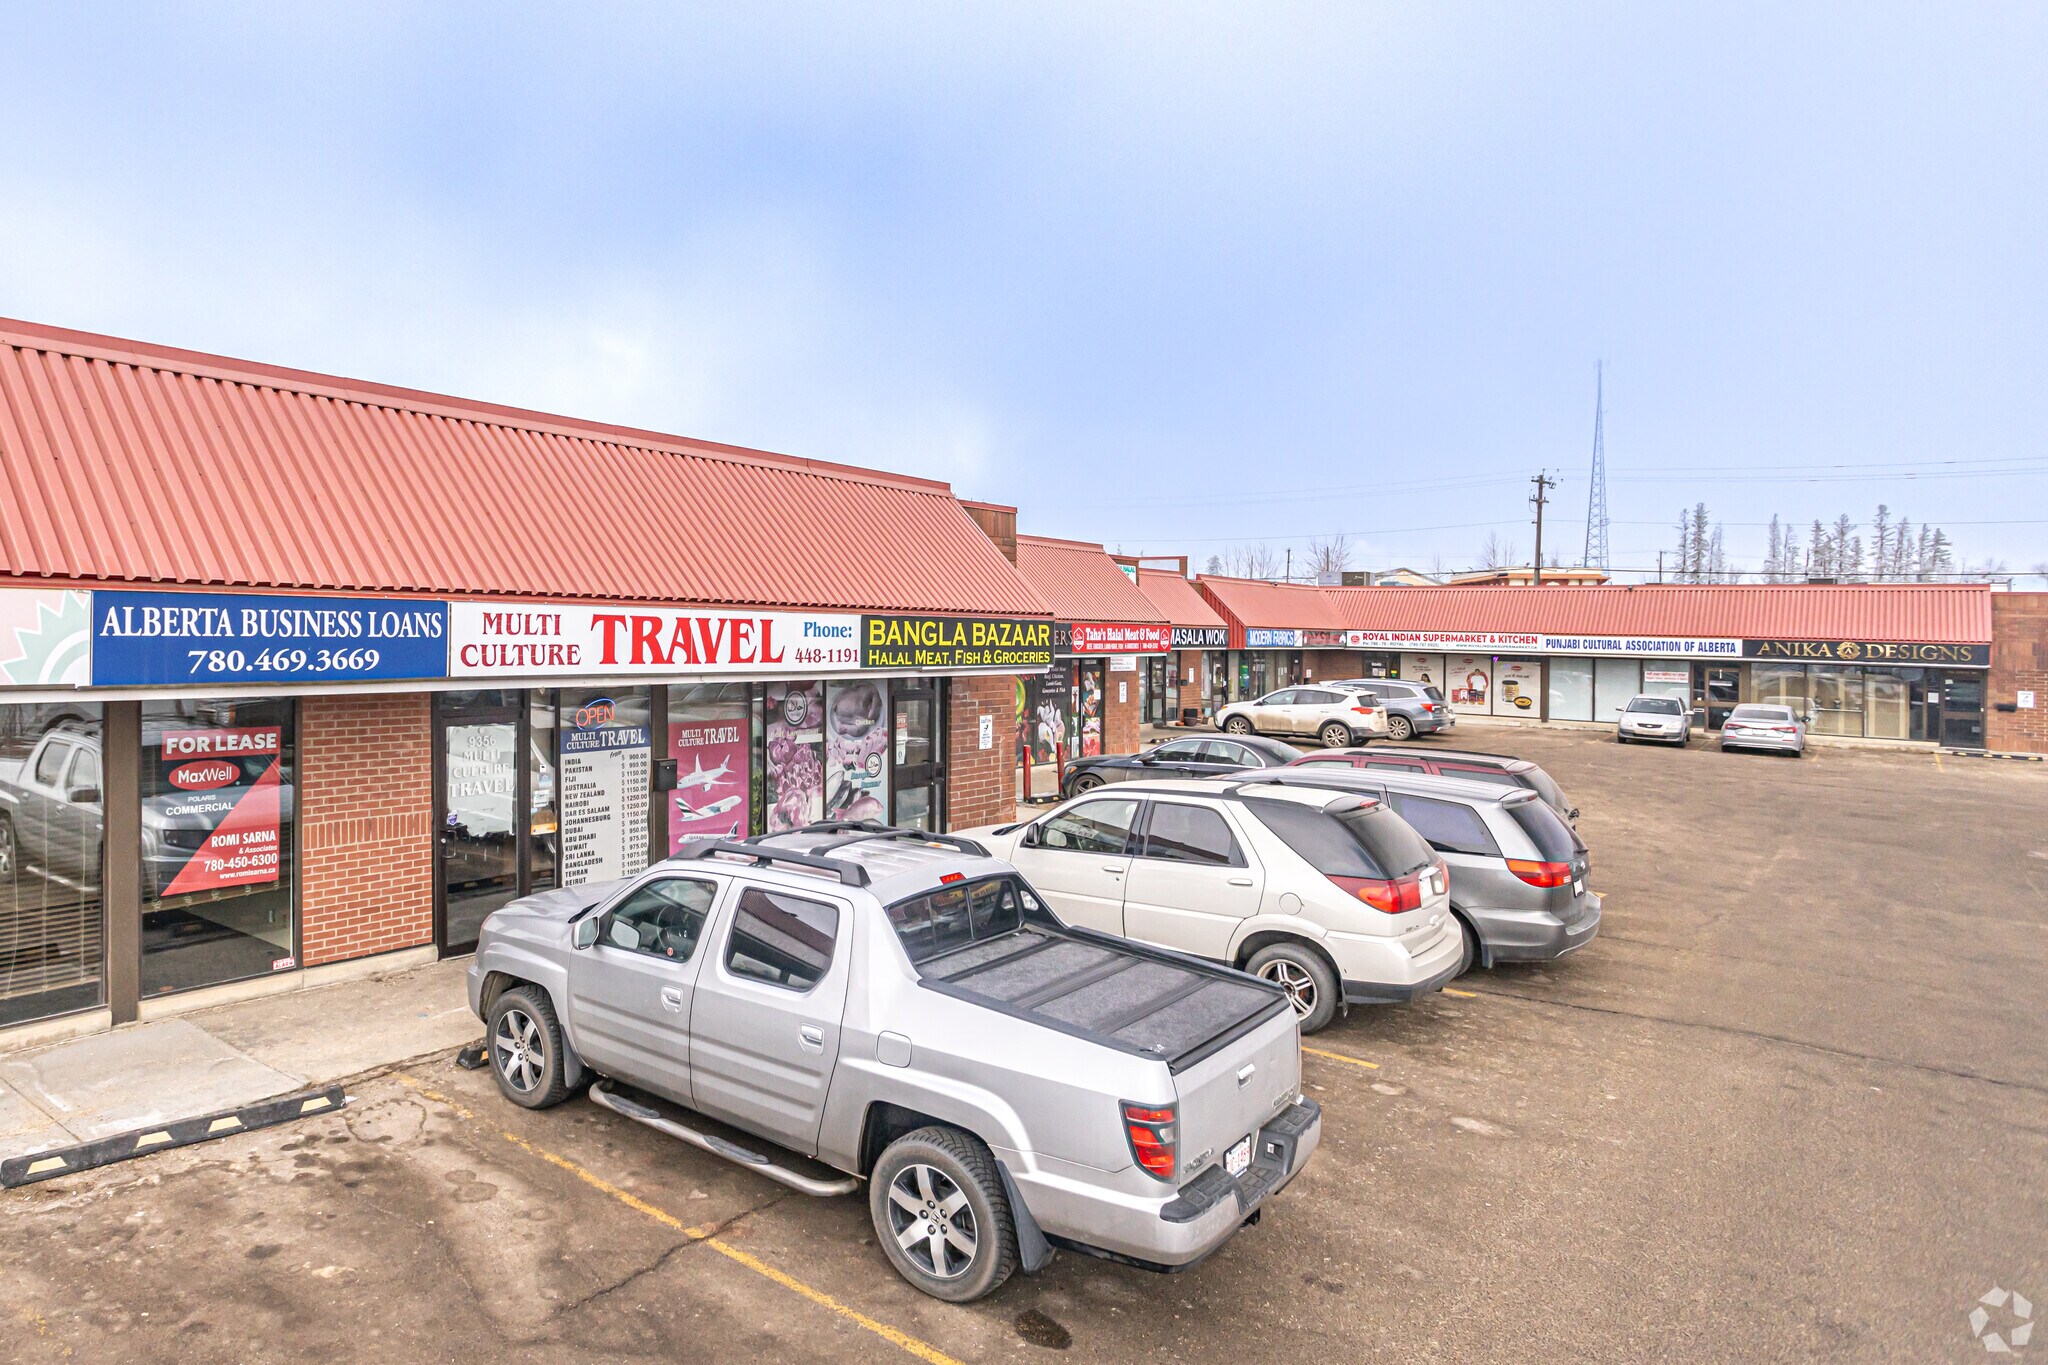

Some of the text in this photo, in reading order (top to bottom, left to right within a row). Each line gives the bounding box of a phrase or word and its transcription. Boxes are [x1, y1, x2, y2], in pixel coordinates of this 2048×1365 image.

[100, 606, 442, 638] ALBERTA BUSINESS LOANS
[803, 621, 852, 638] Phone:
[482, 612, 786, 665] MULTI TRAVEL
[869, 619, 1050, 647] BANGLA BAZAAR
[1086, 627, 1160, 641] Taha's Halal Meat & Food
[1205, 629, 1225, 645] WOK
[1250, 630, 1272, 645] MODERN
[1273, 630, 1293, 645] FABRICS
[1363, 633, 1538, 644] ROYAL INDIAN SUPERMARKET & KITCHEN
[1546, 639, 1736, 653] PUNJABI CULTURAL ASSOCIATION OF ALBERTA
[1757, 641, 1972, 662] ANIKA DESIGNS
[187, 649, 380, 674] 780.469.3669
[460, 644, 581, 667] CULTURE
[795, 647, 859, 663] 448-1191
[868, 650, 1050, 666] HALAL MEAT, FISH & GROCERIES
[576, 704, 615, 727] OPEN
[166, 733, 277, 754] FOR LEASE
[468, 736, 496, 748] 9356
[571, 729, 645, 747] MULTI TRAVEL
[678, 737, 704, 747] CULTURE
[682, 727, 739, 745] MULTI TRAVEL
[566, 740, 600, 750] CULTURE
[463, 750, 500, 761] MULTI
[178, 767, 232, 783] MaxWell
[453, 762, 509, 778] CULTURE
[565, 766, 592, 774] PAKISTAN
[629, 761, 647, 769] 999.00
[565, 775, 576, 783] FIJI
[565, 782, 596, 791] AUSTRALIA
[449, 778, 515, 798] TRAVEL
[580, 789, 605, 798] ZEALAND
[166, 802, 235, 816] COMMERCIAL
[565, 801, 589, 809] NAIROBI
[587, 806, 609, 814] SALAAM
[565, 814, 610, 826] JOHANNESBURG
[626, 810, 647, 818] 1150.00
[629, 818, 647, 826] 950.00
[211, 830, 276, 848] ROMI SARNA
[565, 843, 587, 852] KUWAIT
[629, 834, 647, 842] 975.00
[579, 833, 596, 841] DHABI
[244, 845, 277, 854] Associates
[576, 851, 595, 859] LANKA
[204, 853, 277, 872] 780-450-6300
[565, 857, 602, 869] BANGLADESH
[565, 869, 588, 878] TEHRAN
[627, 859, 647, 867] 1050.00
[219, 868, 276, 879] www.romisarna.ca
[565, 877, 586, 886] BEIRUT
